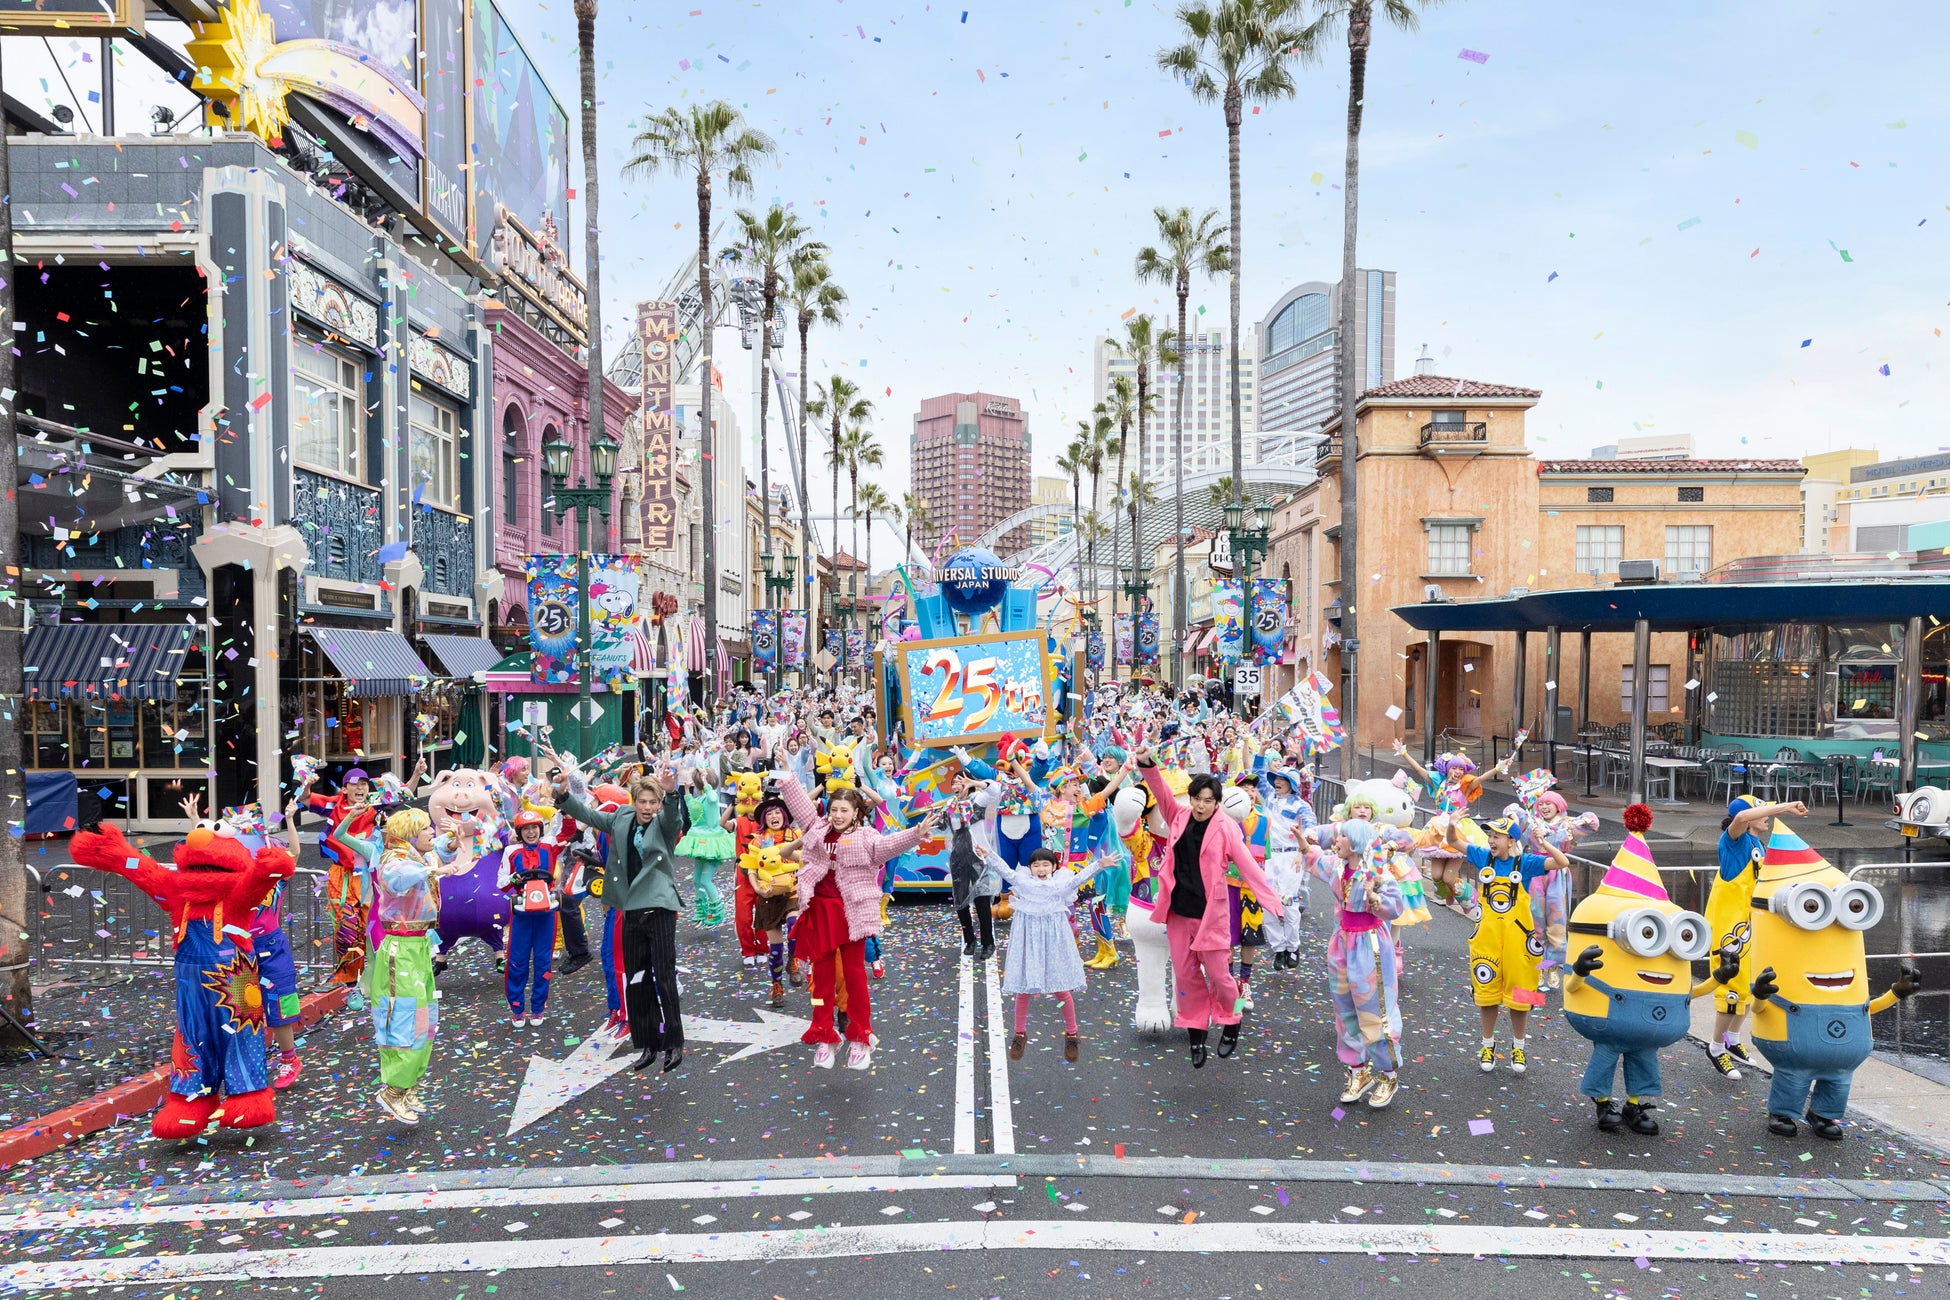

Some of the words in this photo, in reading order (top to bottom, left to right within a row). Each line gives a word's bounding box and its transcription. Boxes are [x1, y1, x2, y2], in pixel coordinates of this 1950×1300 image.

[644, 317, 670, 546] MONTMARTRE
[956, 581, 990, 589] JAPAN
[920, 648, 1041, 732] 25th
[1237, 670, 1259, 684] 35
